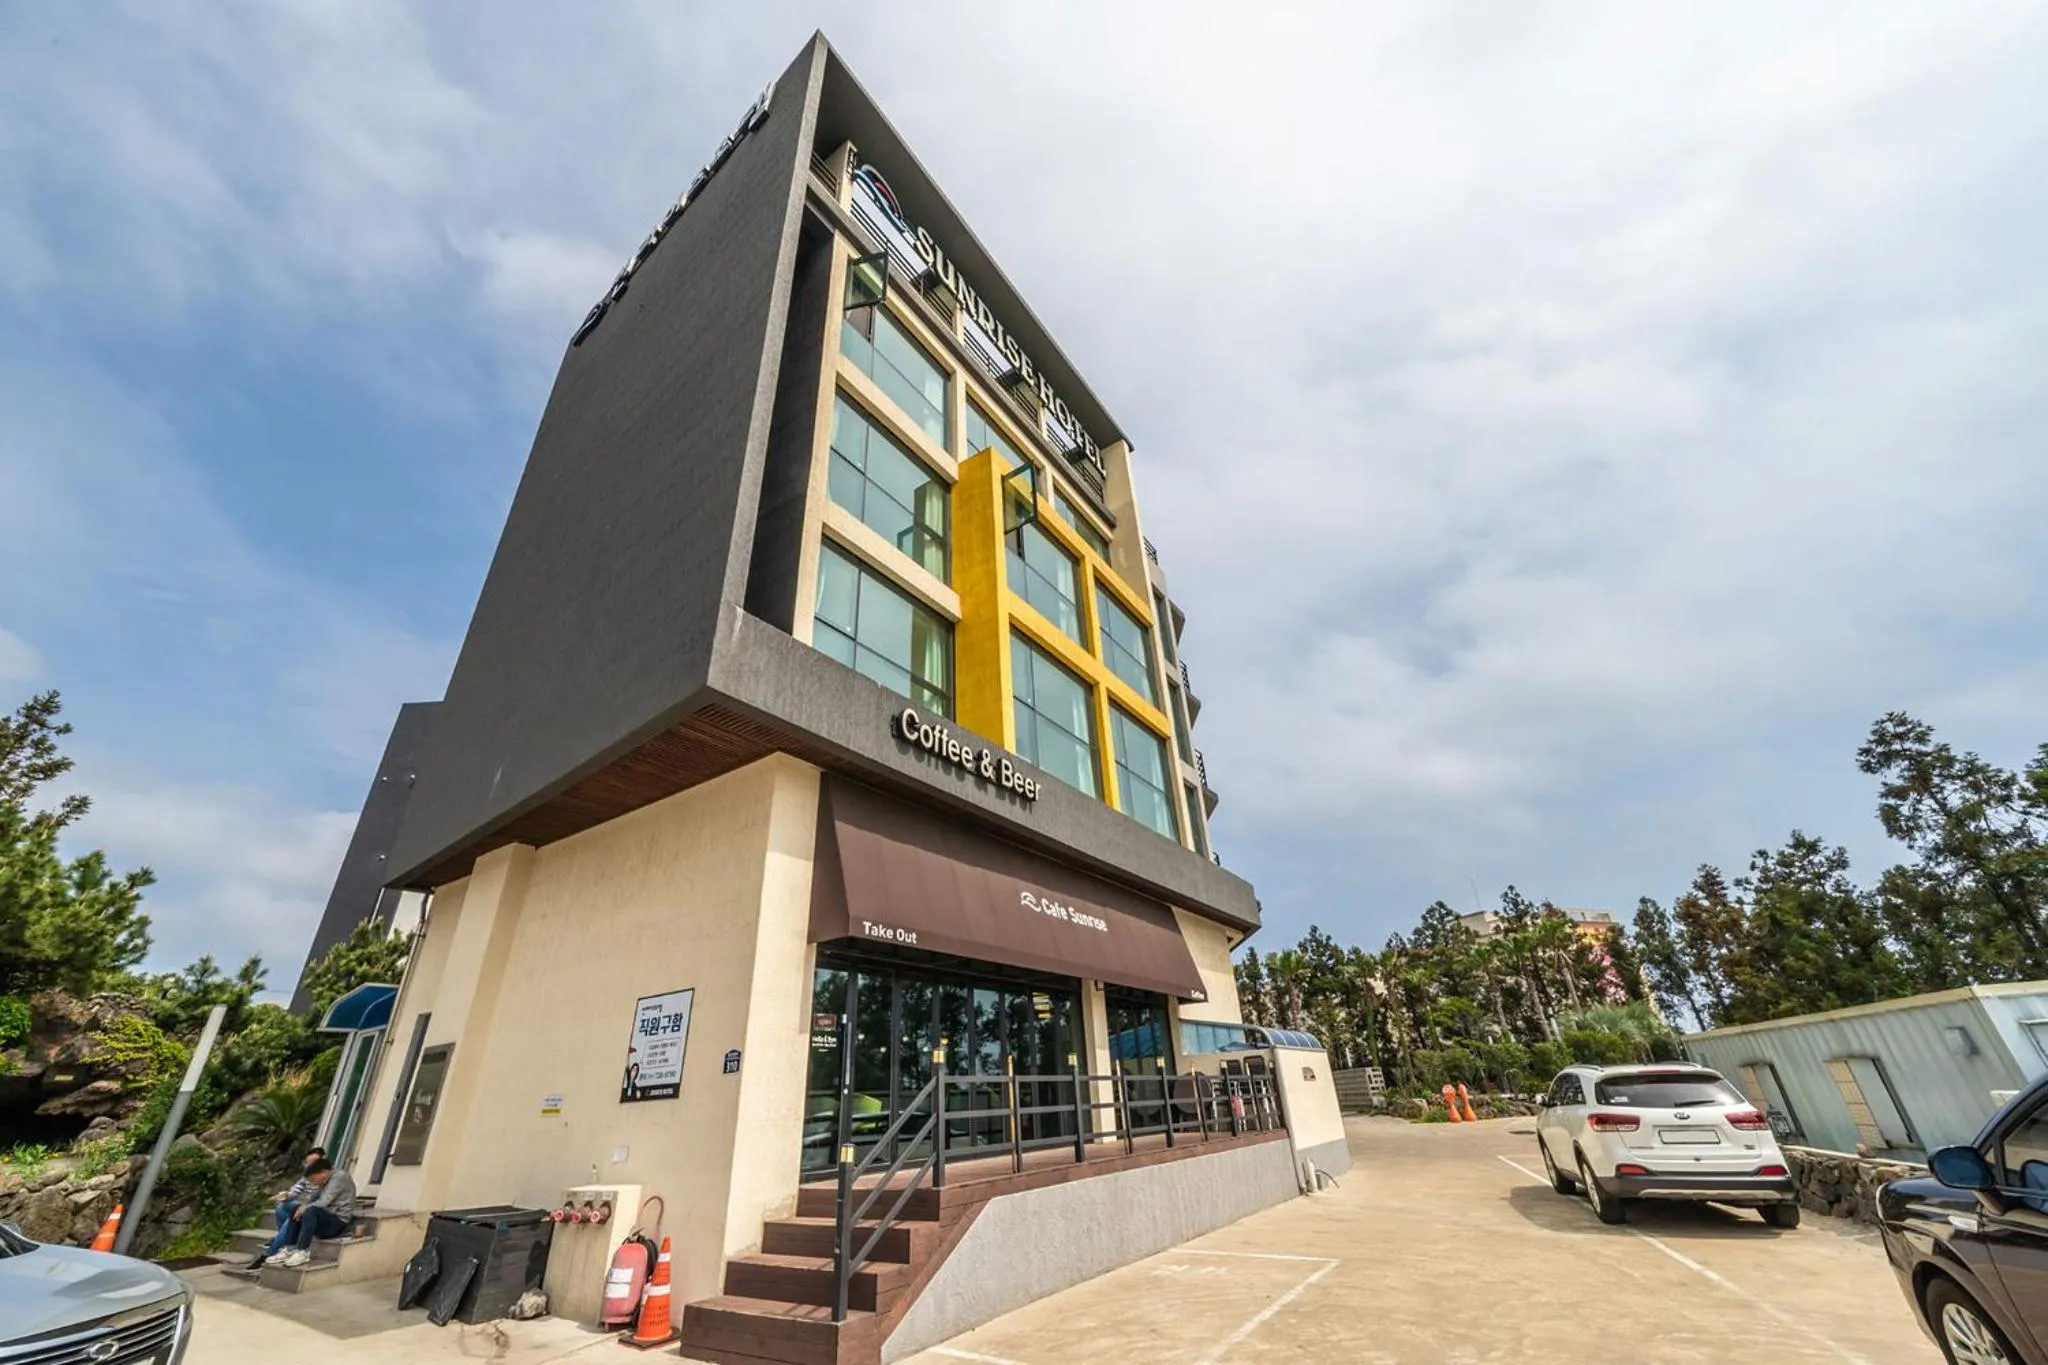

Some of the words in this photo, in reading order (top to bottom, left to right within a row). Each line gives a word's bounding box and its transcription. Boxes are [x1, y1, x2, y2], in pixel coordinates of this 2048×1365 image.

[914, 226, 1035, 387] SUNRISE
[1039, 371, 1107, 480] HOTEL
[901, 707, 974, 769] Coffee
[980, 748, 996, 780] &
[1001, 758, 1042, 801] Beer
[862, 921, 894, 939] Take
[896, 928, 917, 944] Out
[1041, 898, 1068, 920] Cafe
[1068, 907, 1108, 932] Sunrise
